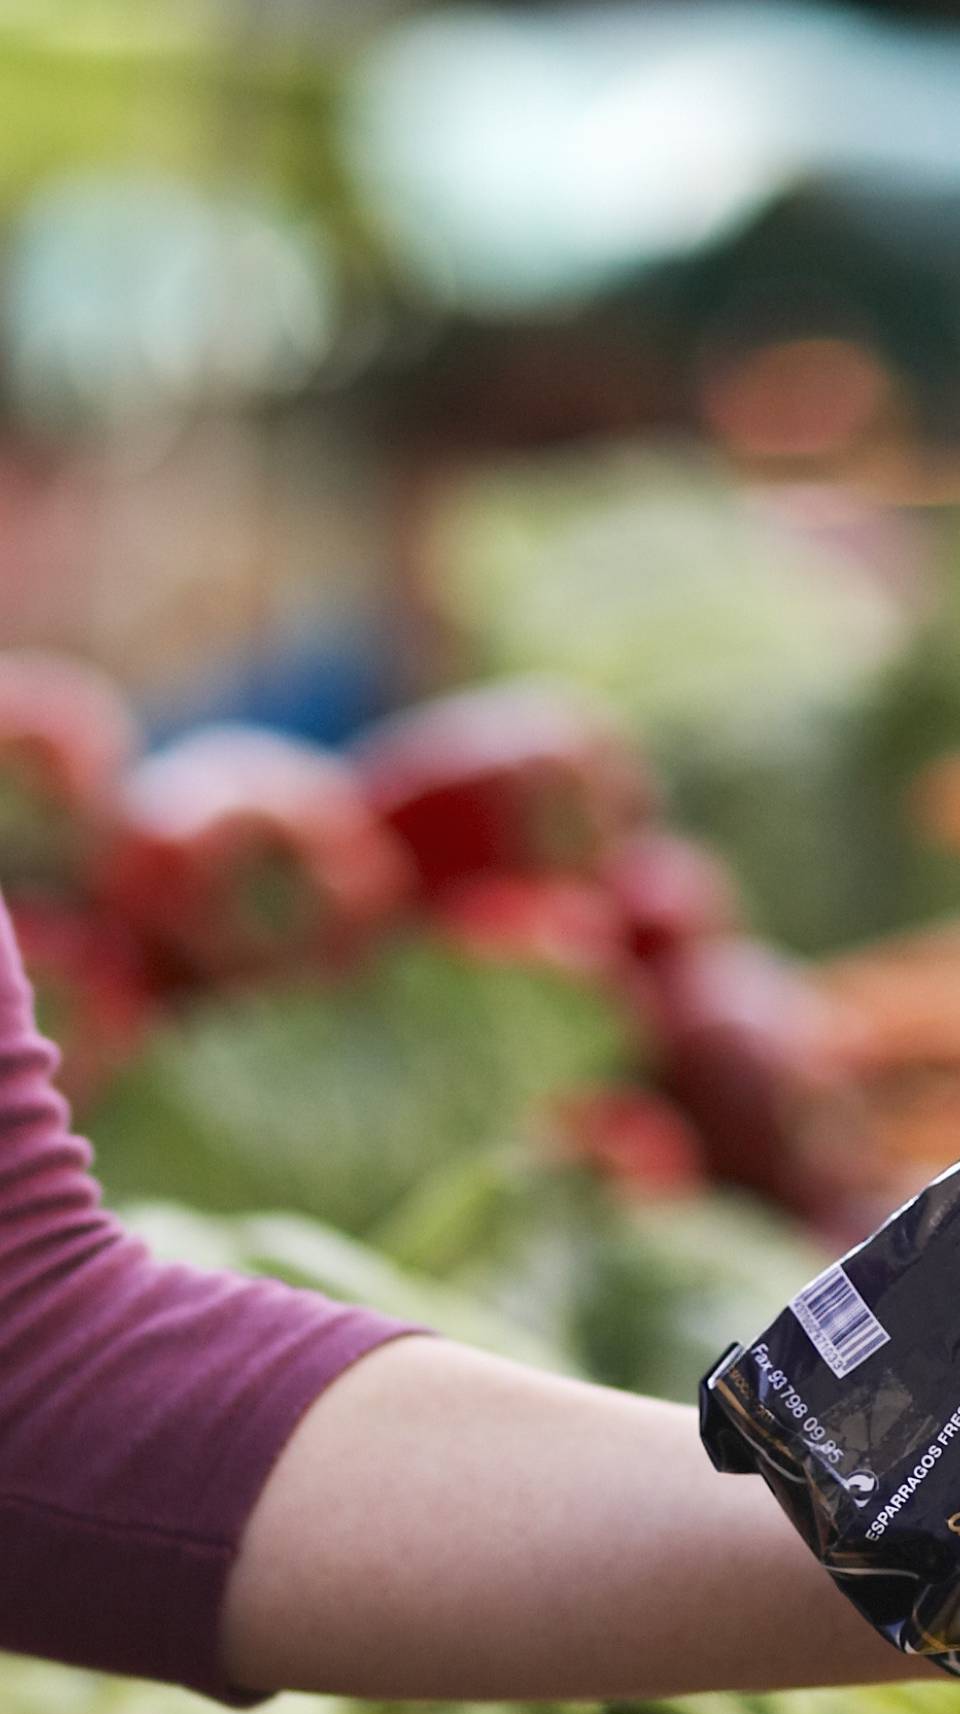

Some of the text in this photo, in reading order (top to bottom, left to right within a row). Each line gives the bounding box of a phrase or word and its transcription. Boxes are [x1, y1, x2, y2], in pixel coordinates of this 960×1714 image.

[752, 1344, 773, 1372] Fax
[768, 1370, 786, 1390] 93
[780, 1388, 808, 1418] 798
[803, 1417, 826, 1440] 09
[865, 1444, 943, 1543] ESPARRAGOS
